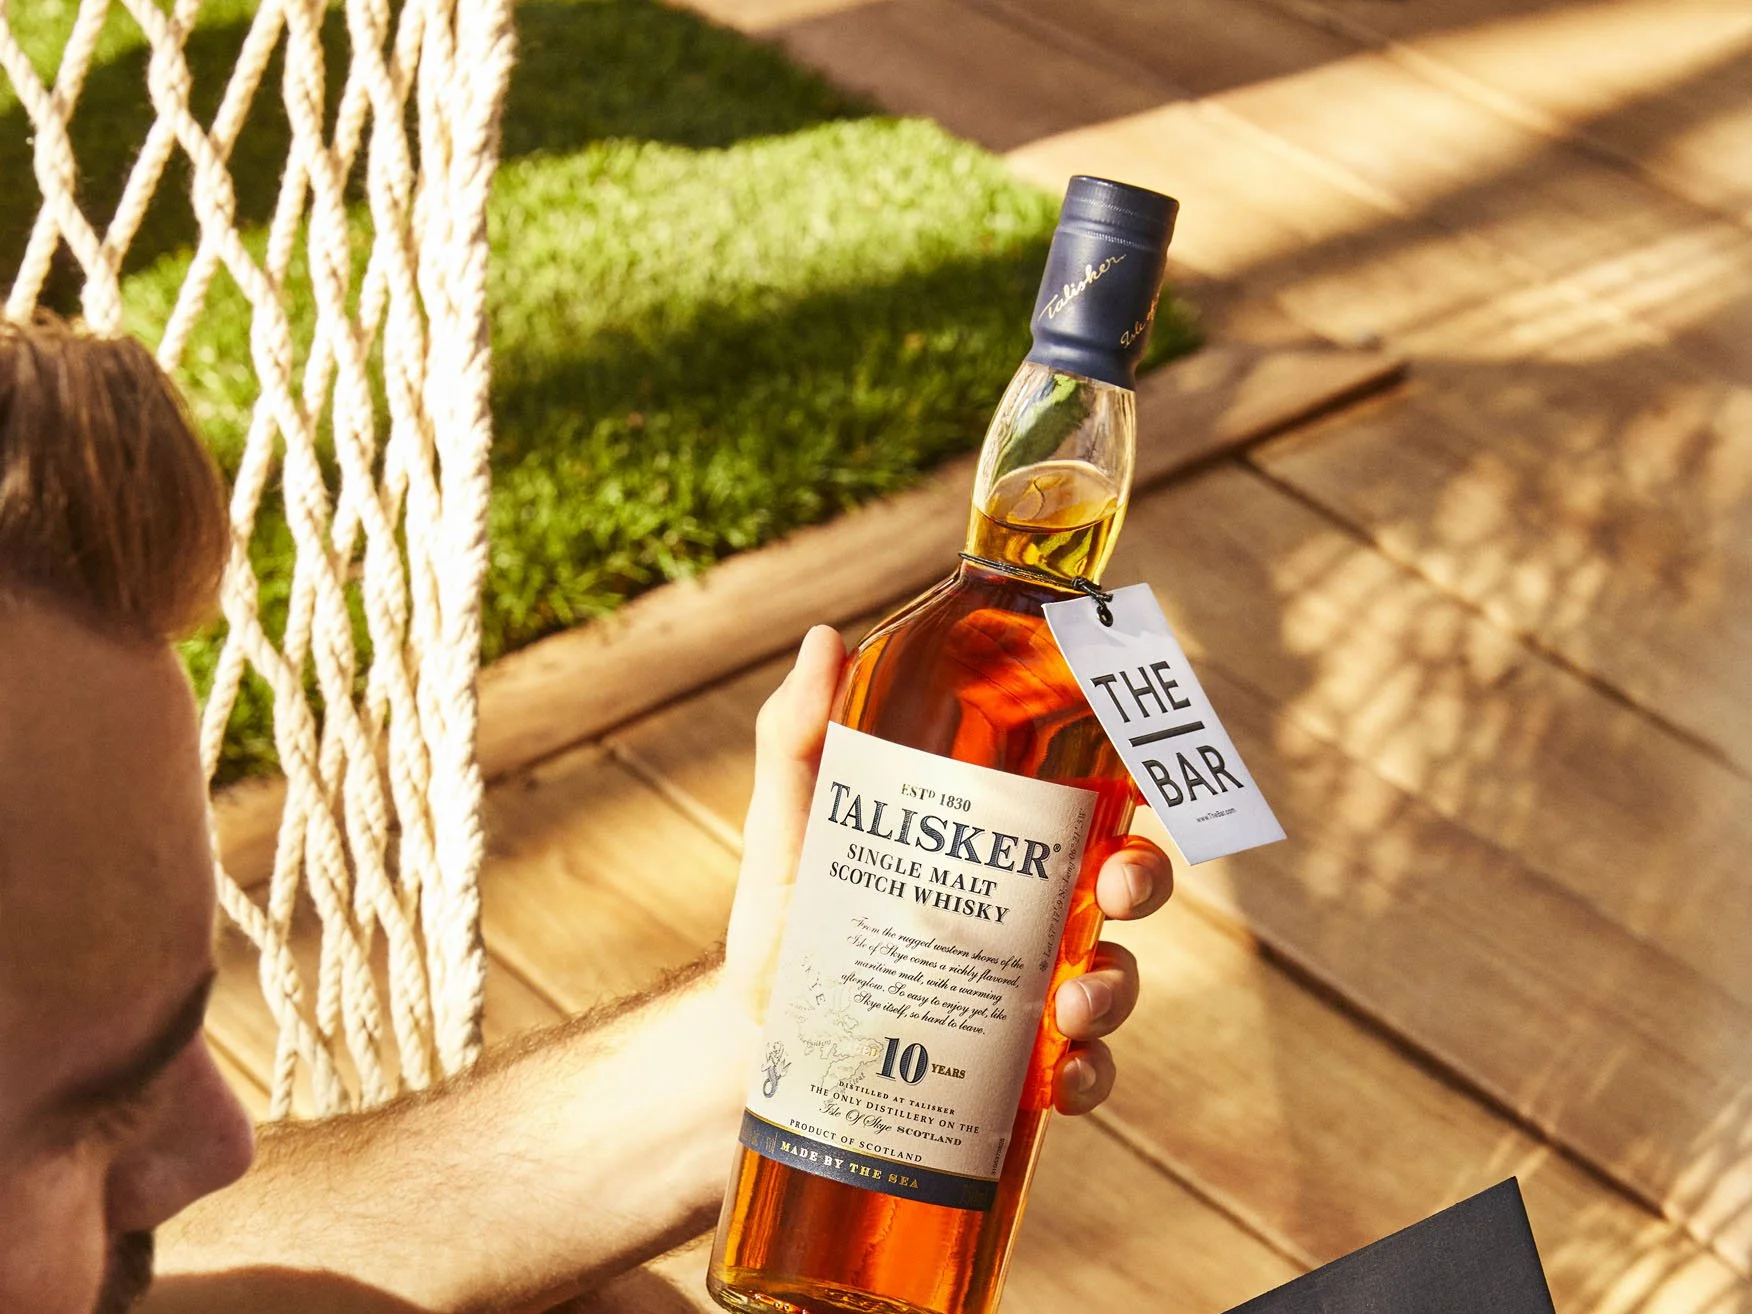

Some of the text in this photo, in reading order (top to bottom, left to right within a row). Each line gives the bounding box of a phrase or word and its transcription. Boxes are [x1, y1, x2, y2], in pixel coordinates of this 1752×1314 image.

[1037, 253, 1126, 320] Talisker
[1090, 660, 1192, 723] THE
[1141, 745, 1245, 808] BAR
[939, 793, 972, 812] 1830
[829, 861, 1010, 925] SCOTCH WHISKY
[847, 843, 997, 898] SINGLE MALT
[847, 935, 867, 949] Isle
[869, 943, 881, 956] of
[880, 942, 909, 962] Skye
[910, 956, 938, 969] comes
[949, 964, 979, 982] richly
[978, 968, 1019, 988] flavored,
[851, 916, 1025, 971] From the rugged western shores of the
[841, 972, 1007, 1022] afterglow. So easy to enjoy yet, like
[854, 958, 1003, 1005] maritime malt, with a warming
[853, 991, 986, 1035] Skye itself, so hard to leave.
[876, 1036, 966, 1086] 10 YEARS
[810, 1084, 981, 1134] THE ONLY DISTILLERY ON THE
[839, 1081, 956, 1115] DISTILLED AT TALISKER
[789, 1118, 922, 1163] PRODUCT OF SCOTLAND
[819, 1102, 963, 1146] Isle Of Skye SCOTLAND
[780, 1140, 919, 1189] MADE BY THE SEA
